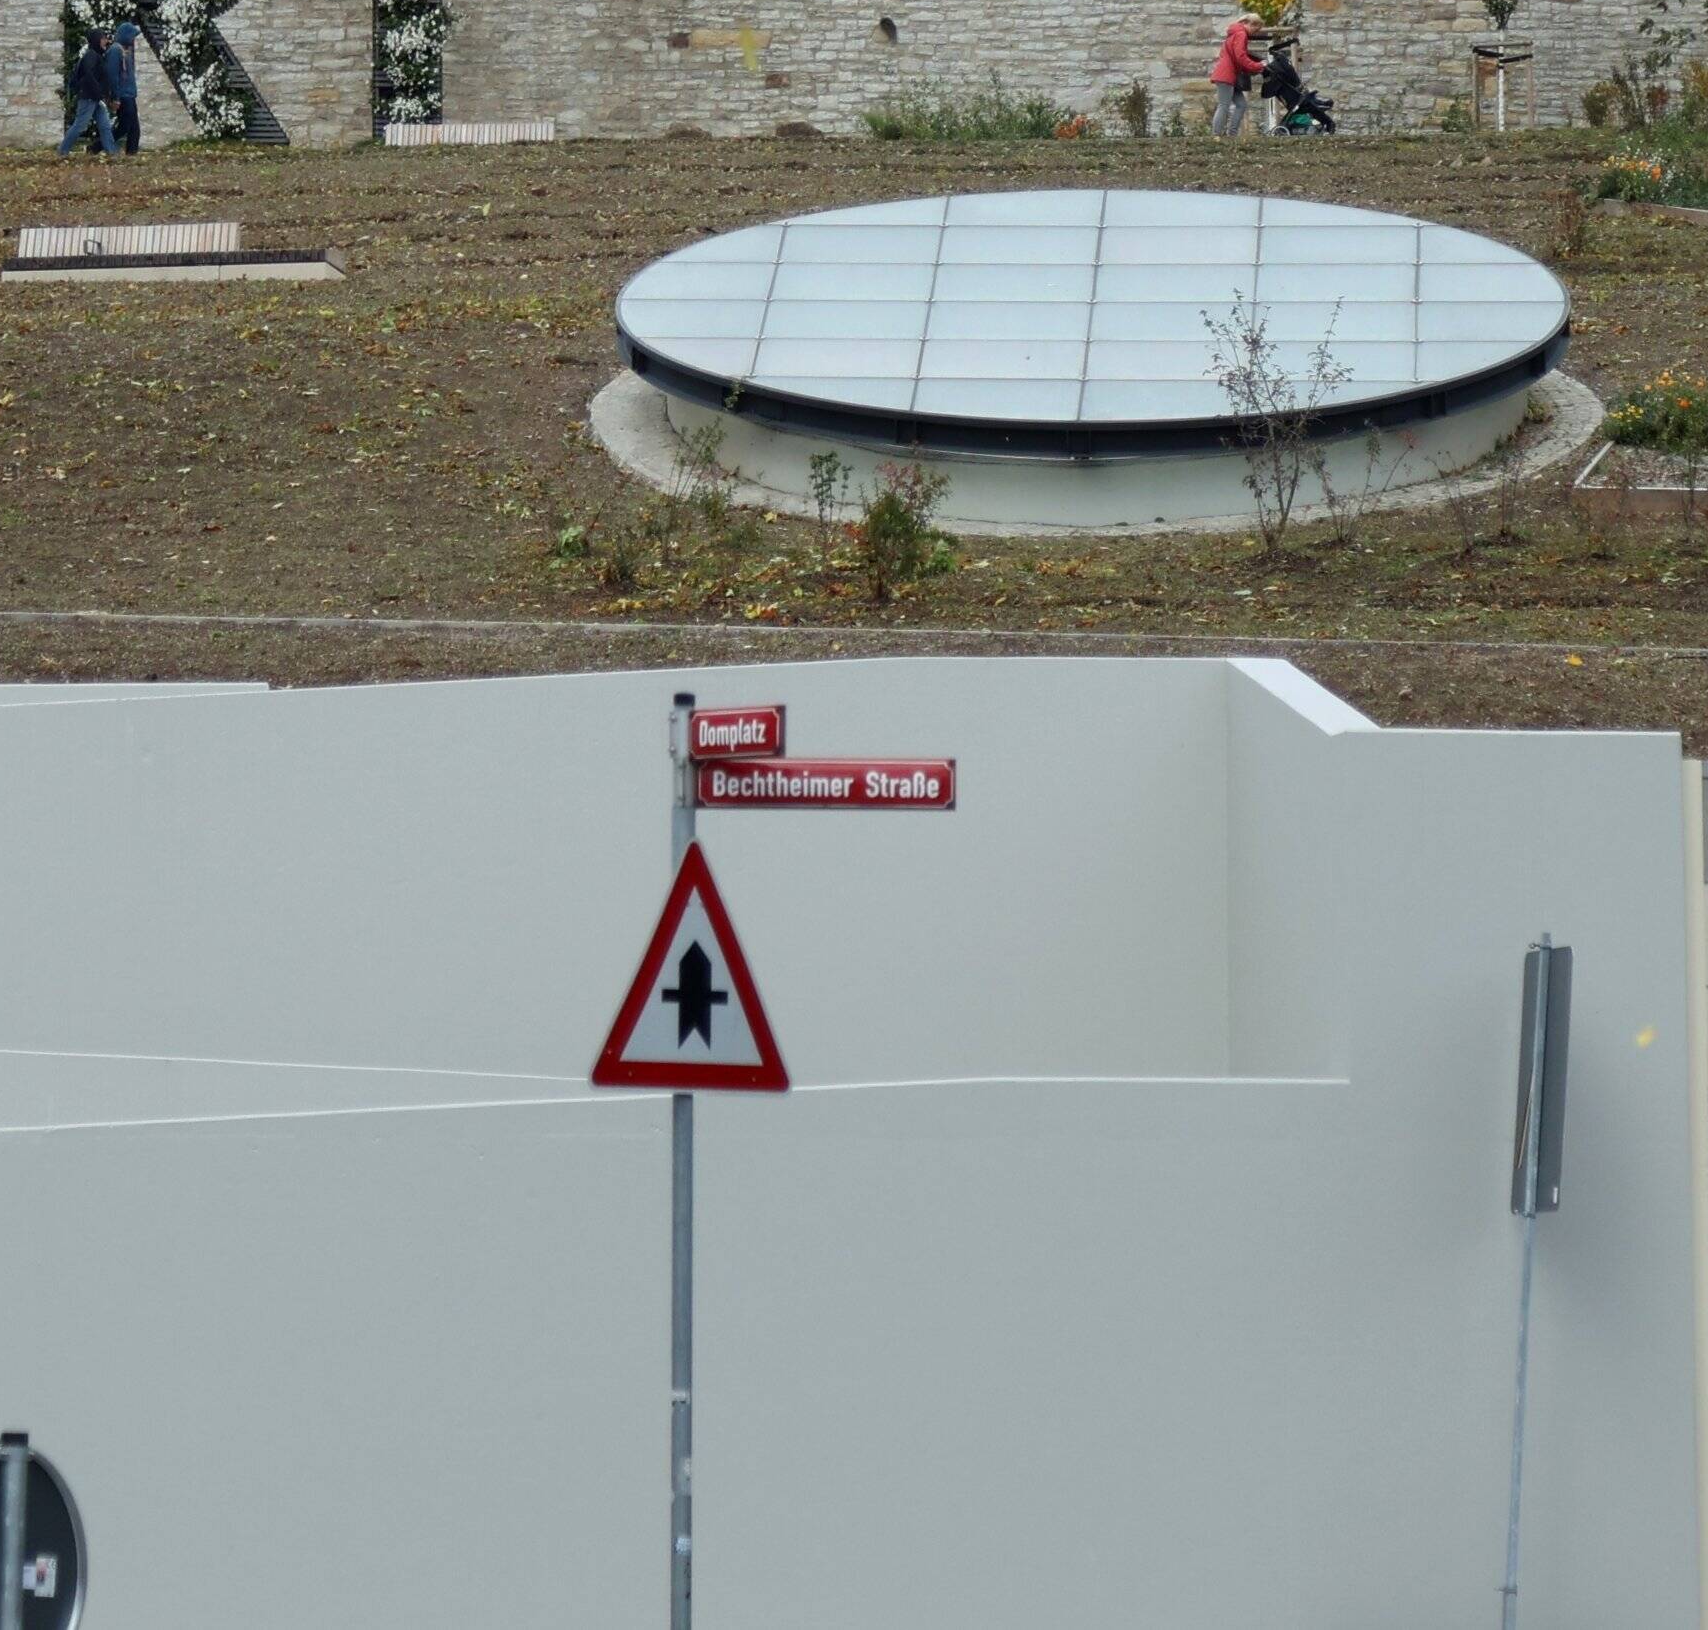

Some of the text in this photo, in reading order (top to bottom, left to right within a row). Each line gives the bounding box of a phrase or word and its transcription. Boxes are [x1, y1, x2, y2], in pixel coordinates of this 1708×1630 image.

[699, 718, 766, 752] Domplatz
[712, 770, 940, 798] Bechtheimer Straße
